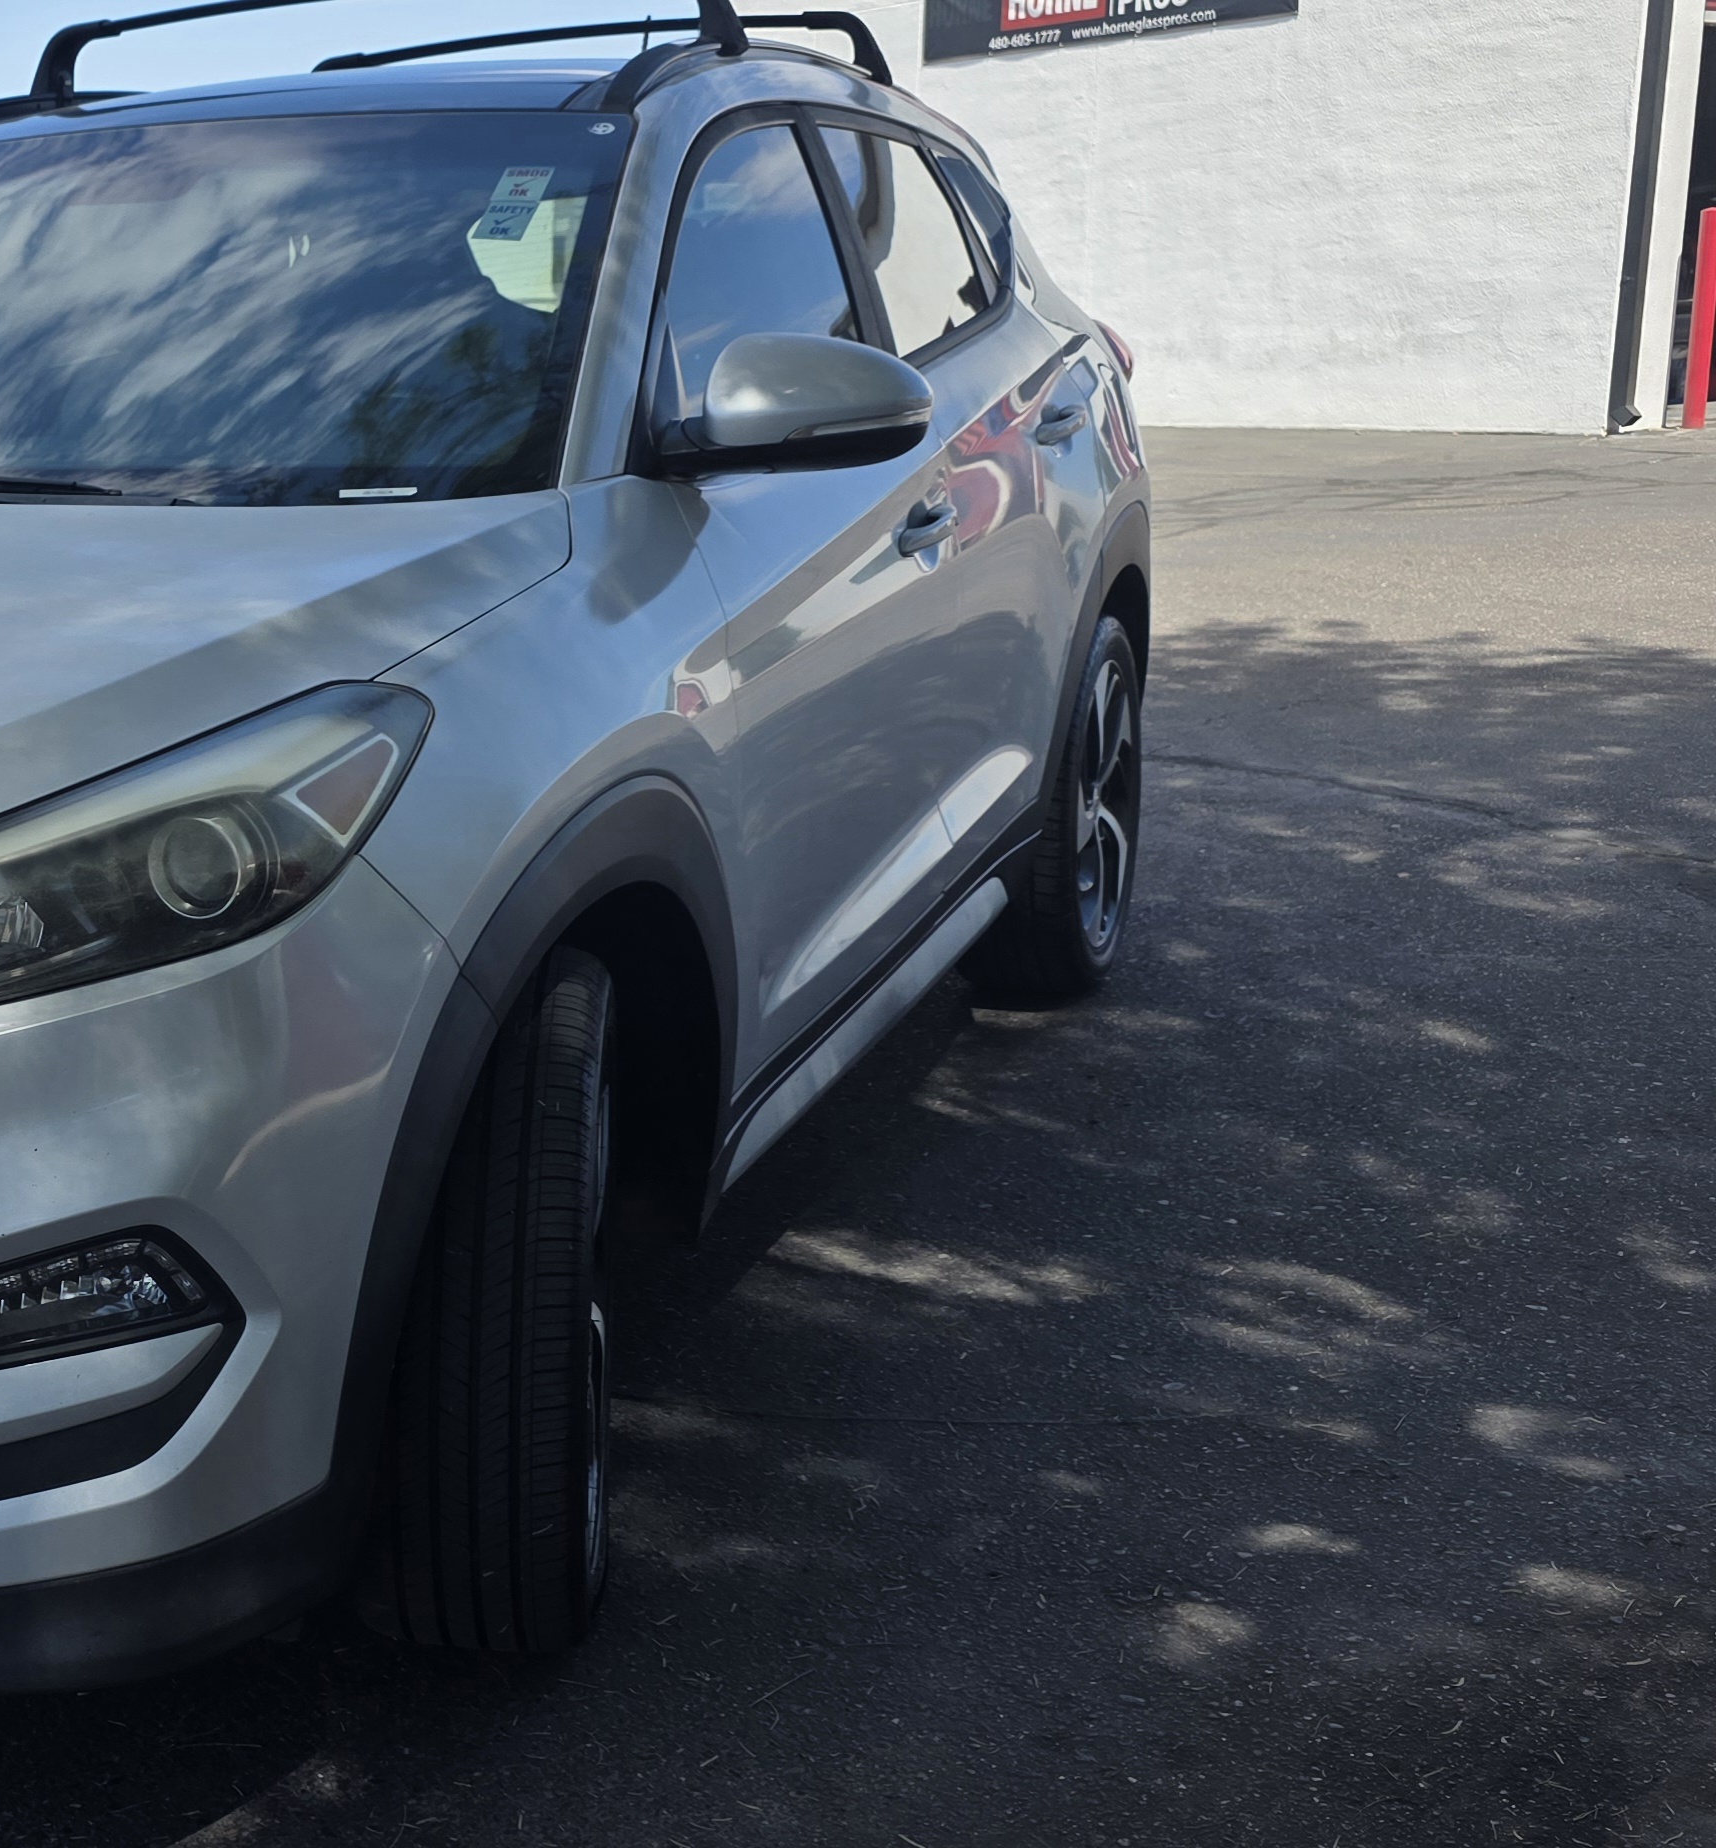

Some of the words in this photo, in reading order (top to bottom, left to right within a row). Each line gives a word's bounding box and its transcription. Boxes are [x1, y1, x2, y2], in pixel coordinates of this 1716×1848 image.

[988, 29, 1061, 50] 480-605-1777
[1071, 9, 1217, 40] www.horneglasspros.com
[509, 188, 530, 196] OK
[489, 205, 536, 214] SAFETY
[489, 227, 511, 235] OK
